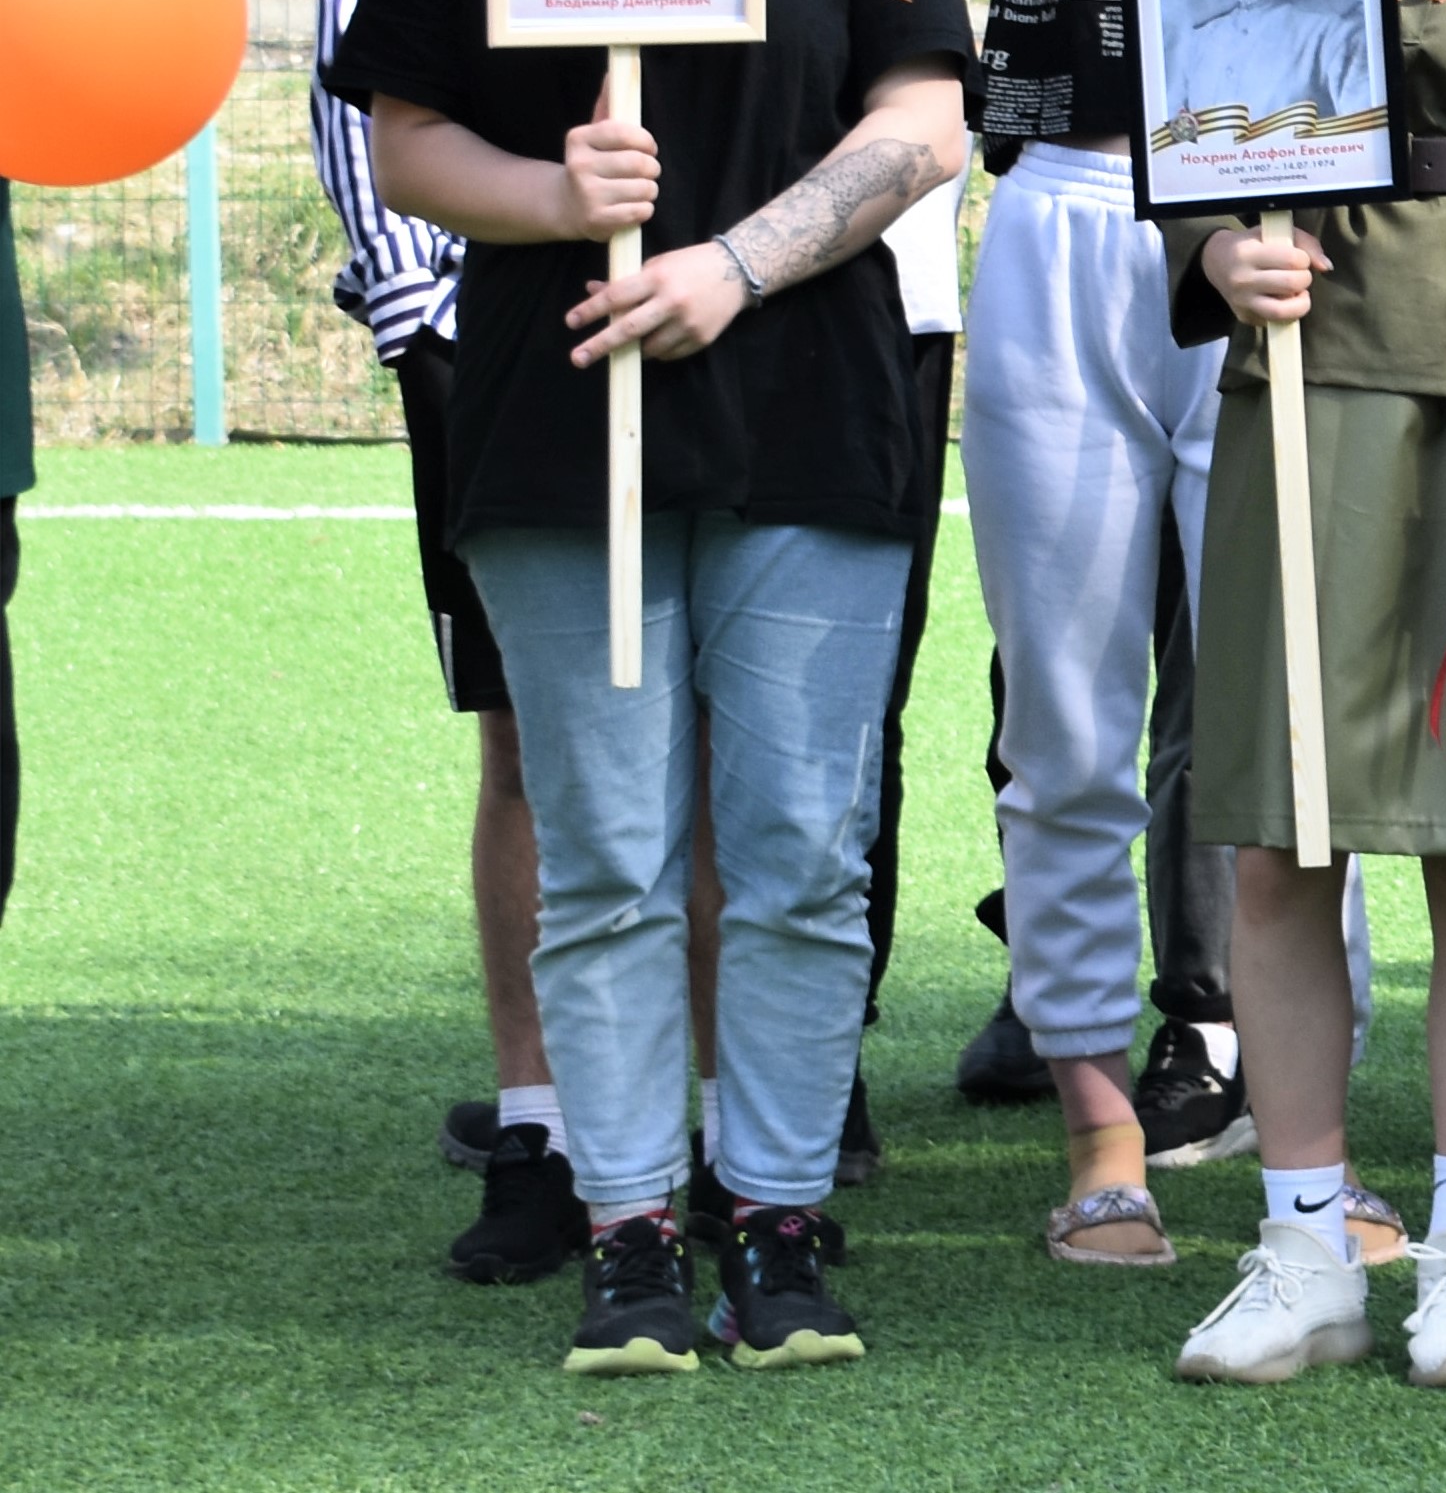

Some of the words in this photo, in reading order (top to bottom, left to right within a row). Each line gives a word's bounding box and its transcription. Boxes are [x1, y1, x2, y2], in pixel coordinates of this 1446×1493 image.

[1180, 152, 1238, 168] Нохрин
[1241, 145, 1297, 163] Агафон
[1299, 142, 1365, 157] Евсеевич
[1239, 172, 1308, 186] красноармеец
